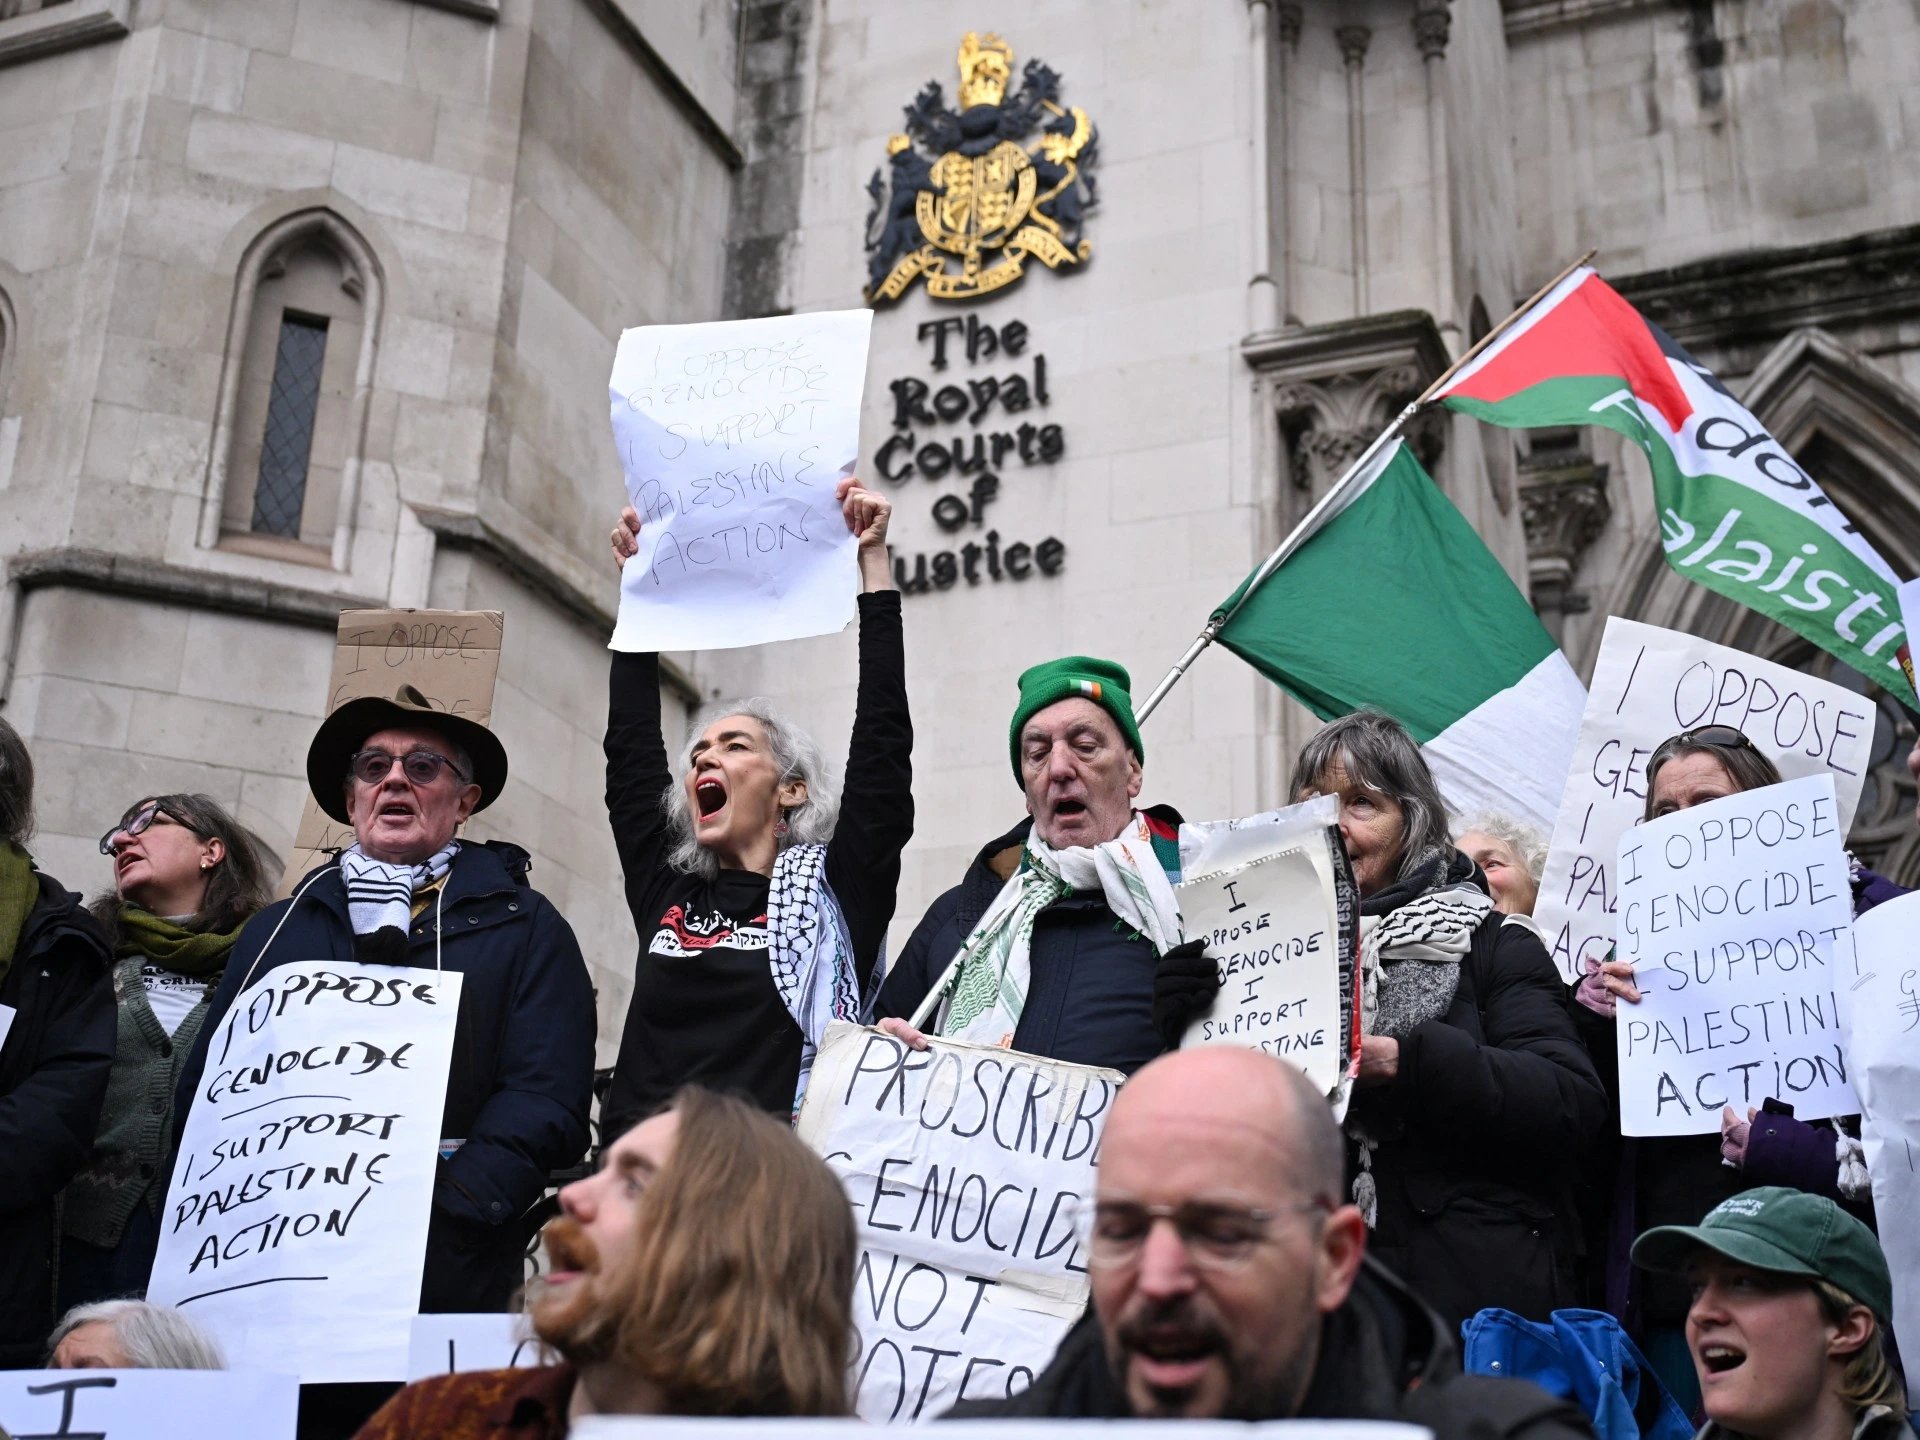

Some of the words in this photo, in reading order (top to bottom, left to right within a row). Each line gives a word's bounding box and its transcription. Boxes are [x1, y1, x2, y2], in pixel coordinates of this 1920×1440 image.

[654, 344, 661, 379] I
[683, 339, 813, 376] OPPOSE
[917, 313, 1028, 371] The
[627, 364, 829, 412] GENOCIDE
[889, 353, 1049, 431] Royal
[629, 440, 634, 466] I
[658, 398, 831, 460] SUPPORT
[873, 421, 1066, 484] Courts
[634, 445, 821, 525] PALESTINE
[931, 471, 999, 534] of
[651, 503, 813, 587] ACTION
[885, 529, 1067, 597] ustice
[346, 630, 375, 676] I
[385, 622, 479, 668] OPPOSE
[1616, 645, 1645, 715] I
[1674, 661, 1865, 777] OPPOSE
[1621, 844, 1643, 886] I
[1665, 797, 1835, 869] OPPOSE
[1223, 881, 1246, 913] I
[1202, 913, 1271, 950] OPPOSE
[1216, 932, 1325, 988] GENOCIDE
[1664, 926, 1848, 991] SUPPORT
[220, 1009, 239, 1065] I
[249, 971, 437, 1034] OPPOSE
[1203, 998, 1307, 1041] SUPPORT
[1240, 976, 1265, 1004] I
[206, 1041, 415, 1104] GENOCIDE
[1250, 1029, 1325, 1056] STINE
[845, 1035, 1099, 1168] PROSCRIB
[182, 1153, 194, 1187] I
[199, 1113, 406, 1181] SUPPORT
[174, 1152, 391, 1234] PALESTINE
[189, 1186, 372, 1274] ACTION
[854, 1250, 1001, 1335] NOT
[11, 1377, 117, 1440] I
